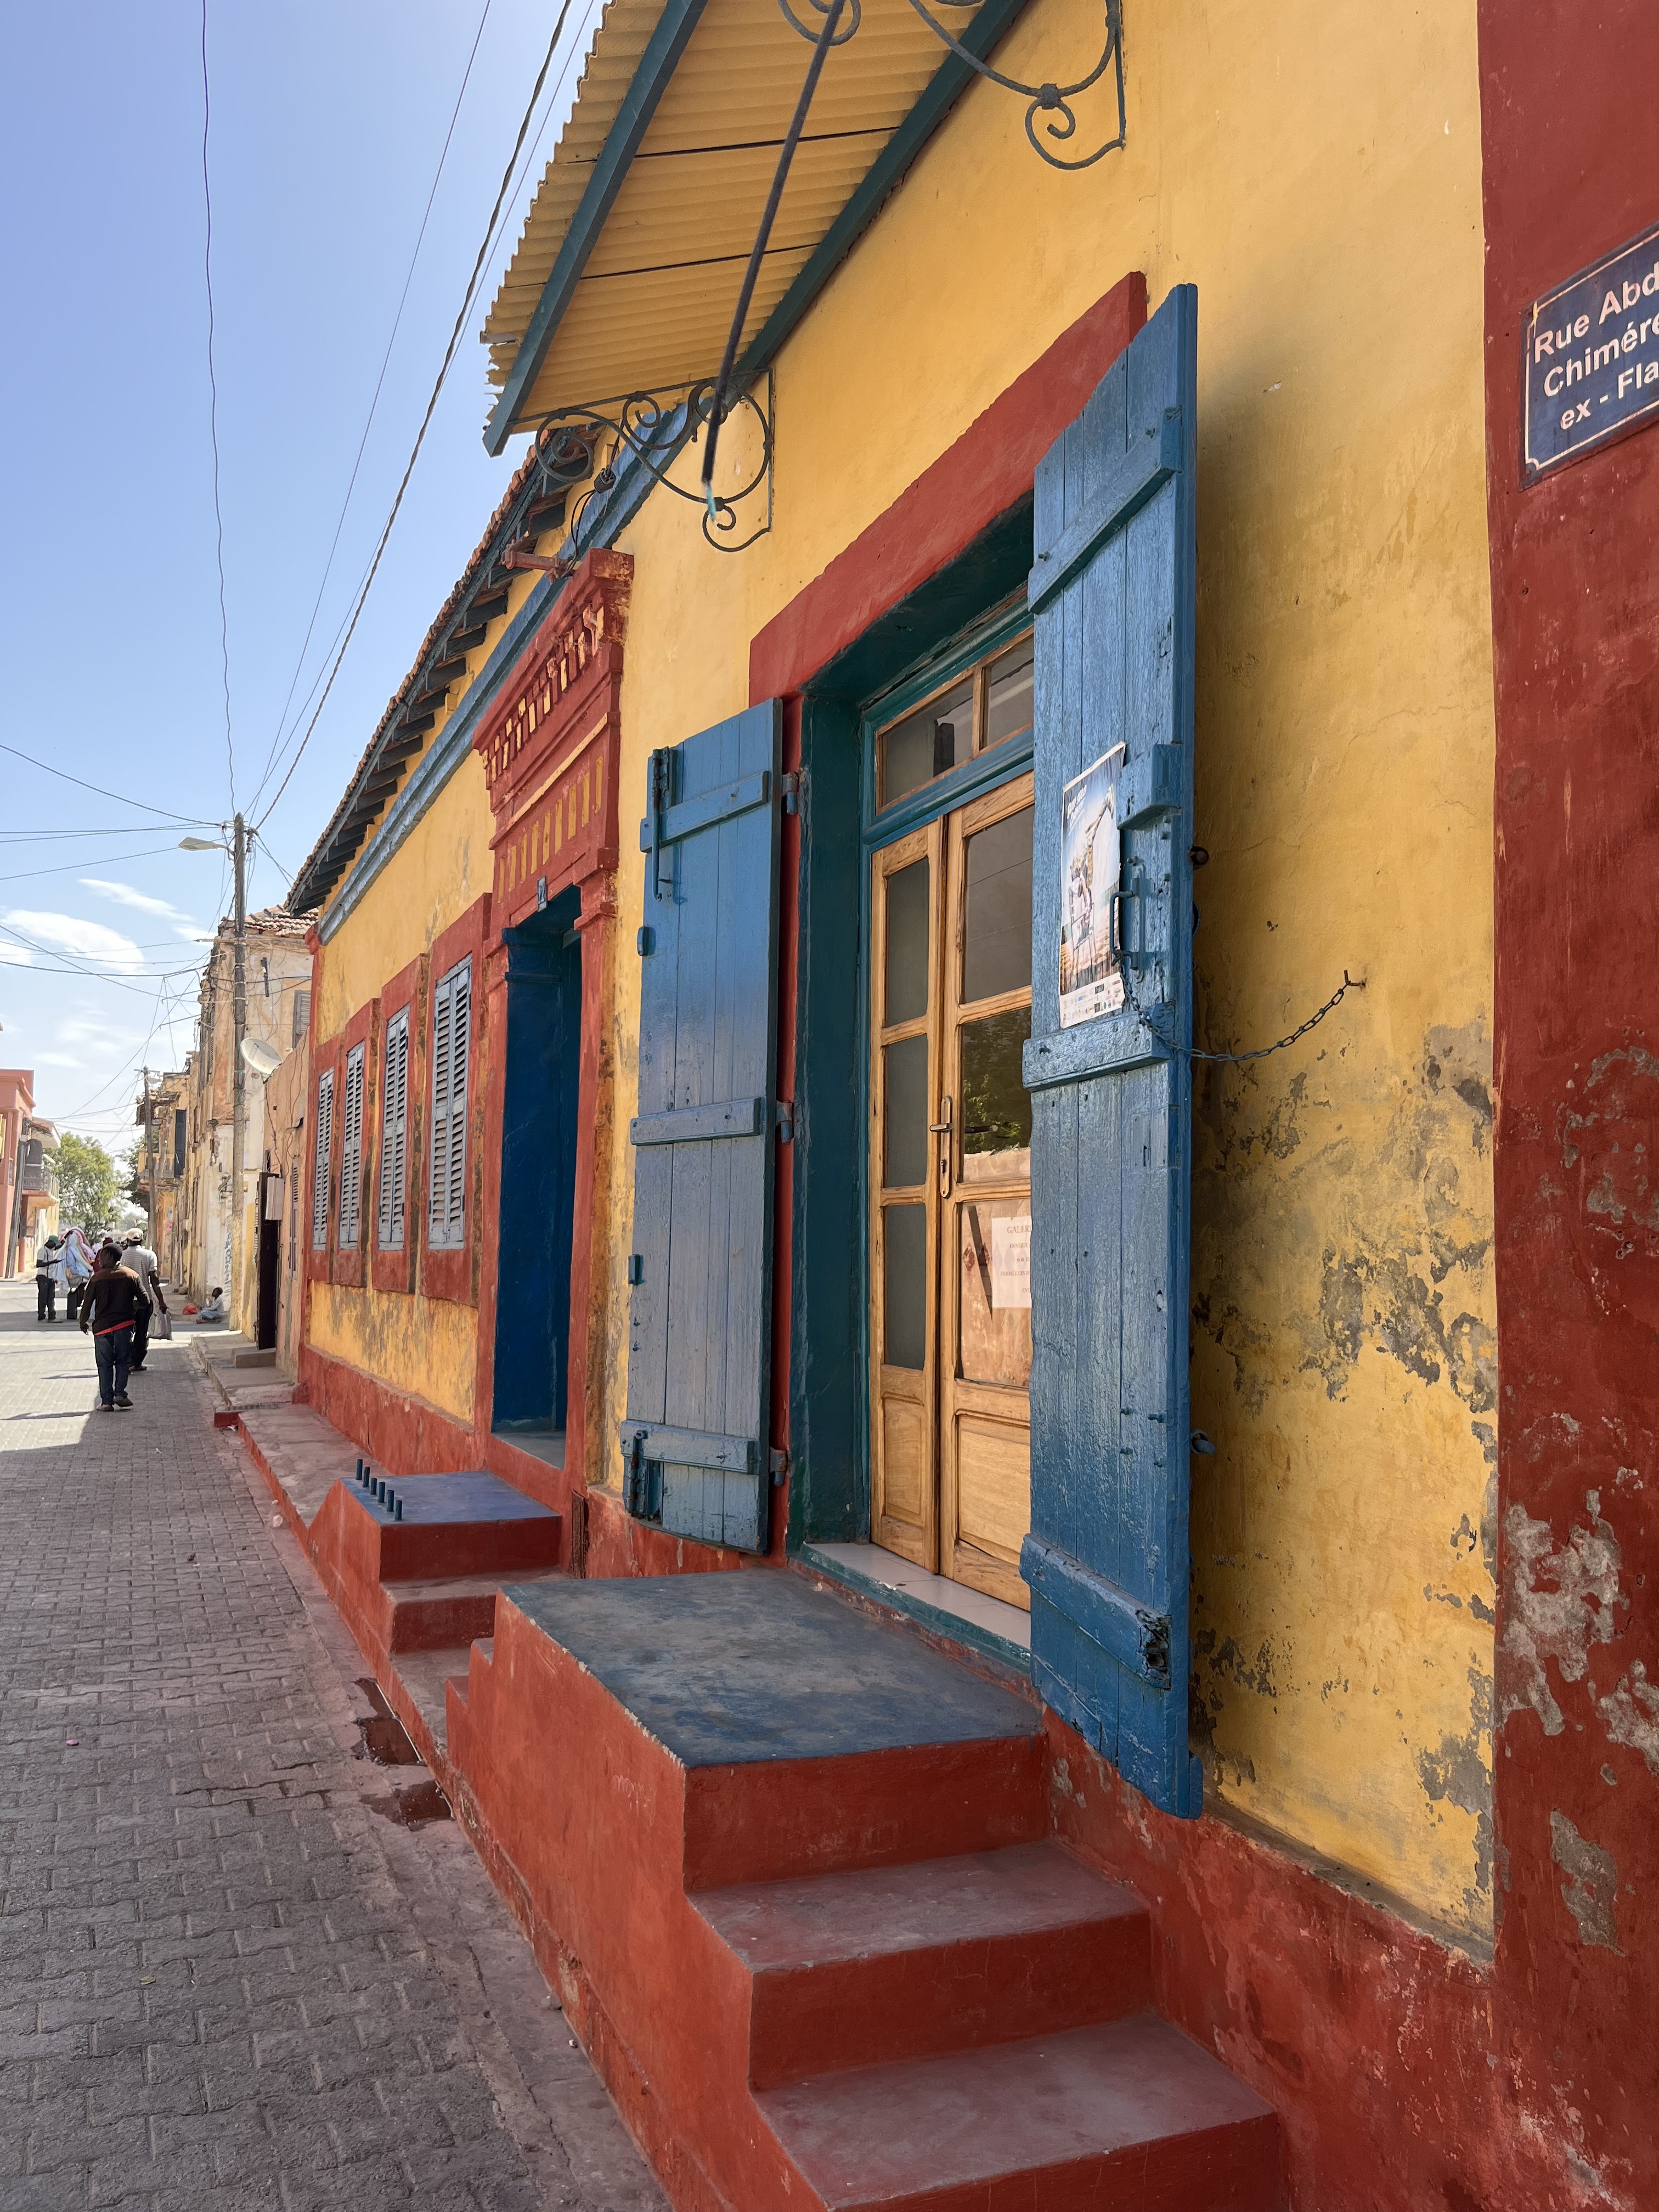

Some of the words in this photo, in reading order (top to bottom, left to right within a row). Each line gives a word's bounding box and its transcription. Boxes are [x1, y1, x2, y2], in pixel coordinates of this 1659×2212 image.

[1534, 314, 1589, 364] Rue
[1560, 398, 1591, 430] ex
[1618, 361, 1658, 399] Fla
